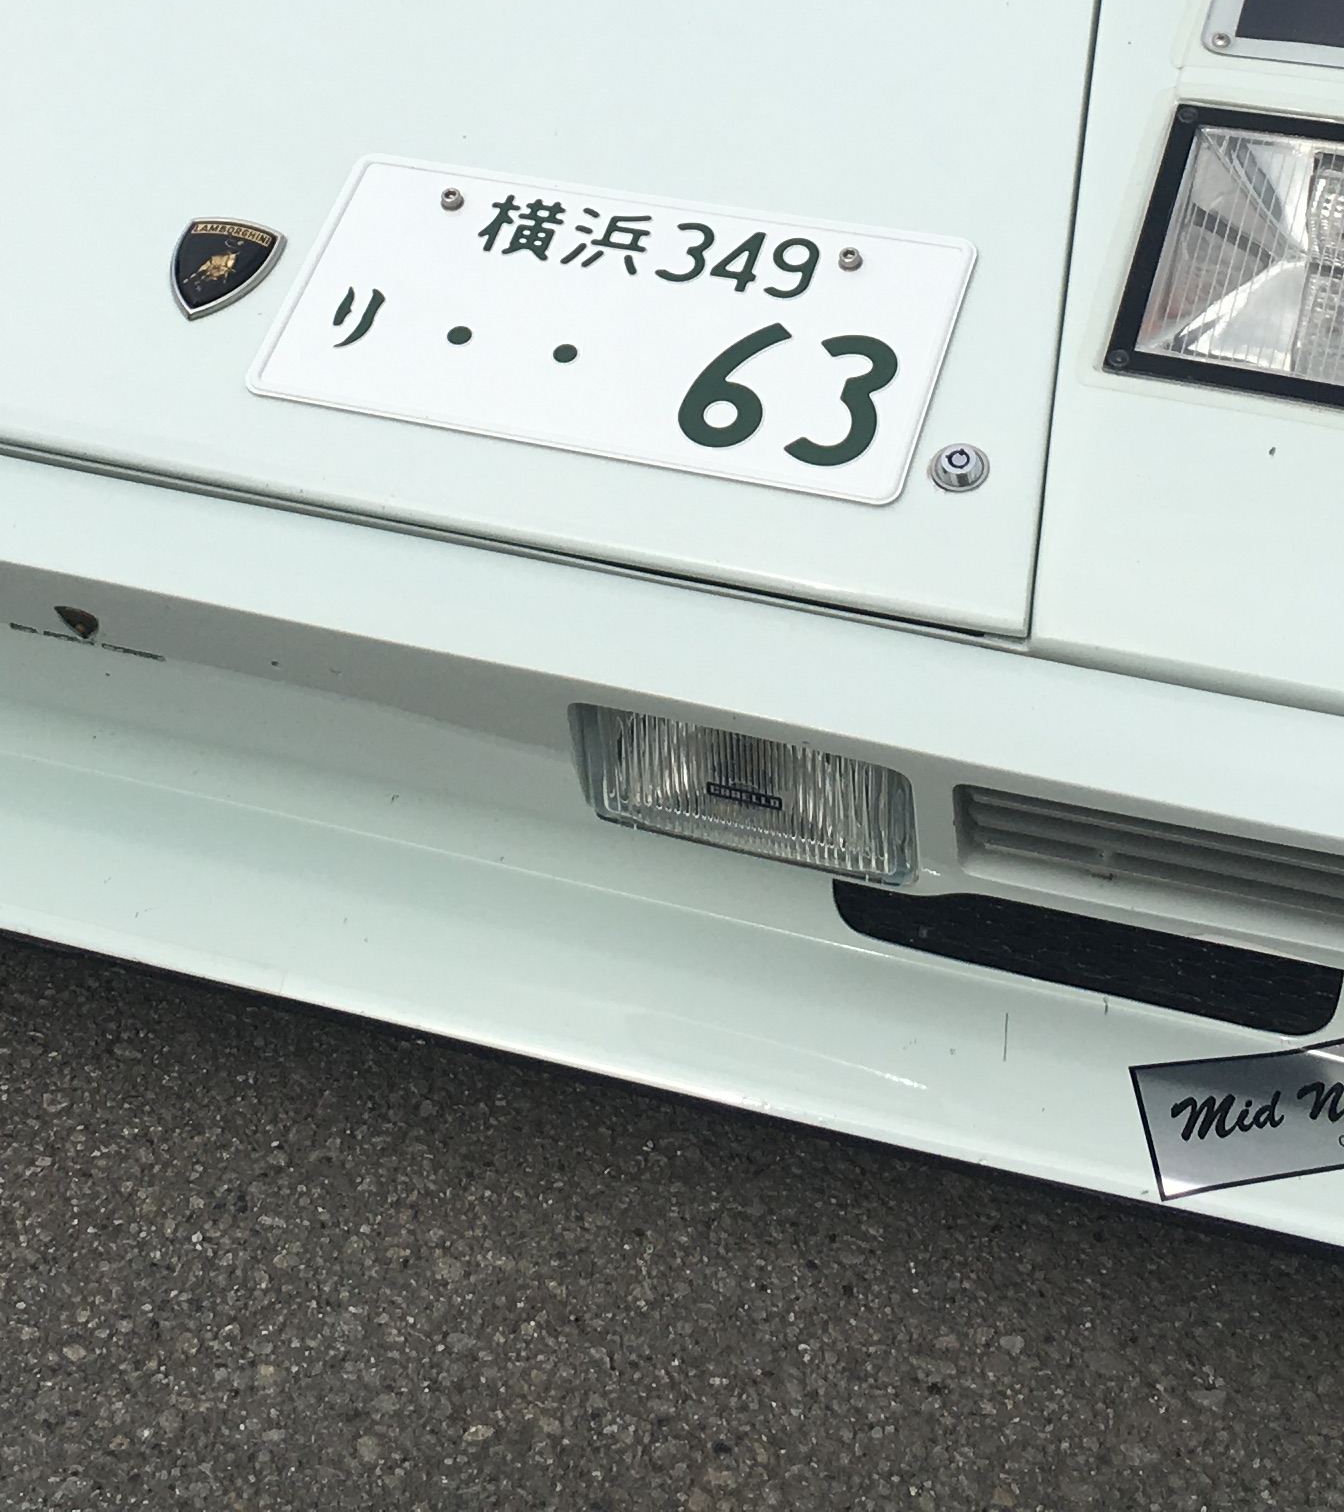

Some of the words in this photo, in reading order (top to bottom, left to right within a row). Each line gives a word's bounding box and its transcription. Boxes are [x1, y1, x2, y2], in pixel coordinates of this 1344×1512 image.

[192, 224, 272, 248] LAMBORGHINI
[332, 287, 386, 347] リ
[1170, 1090, 1286, 1142] Mid
